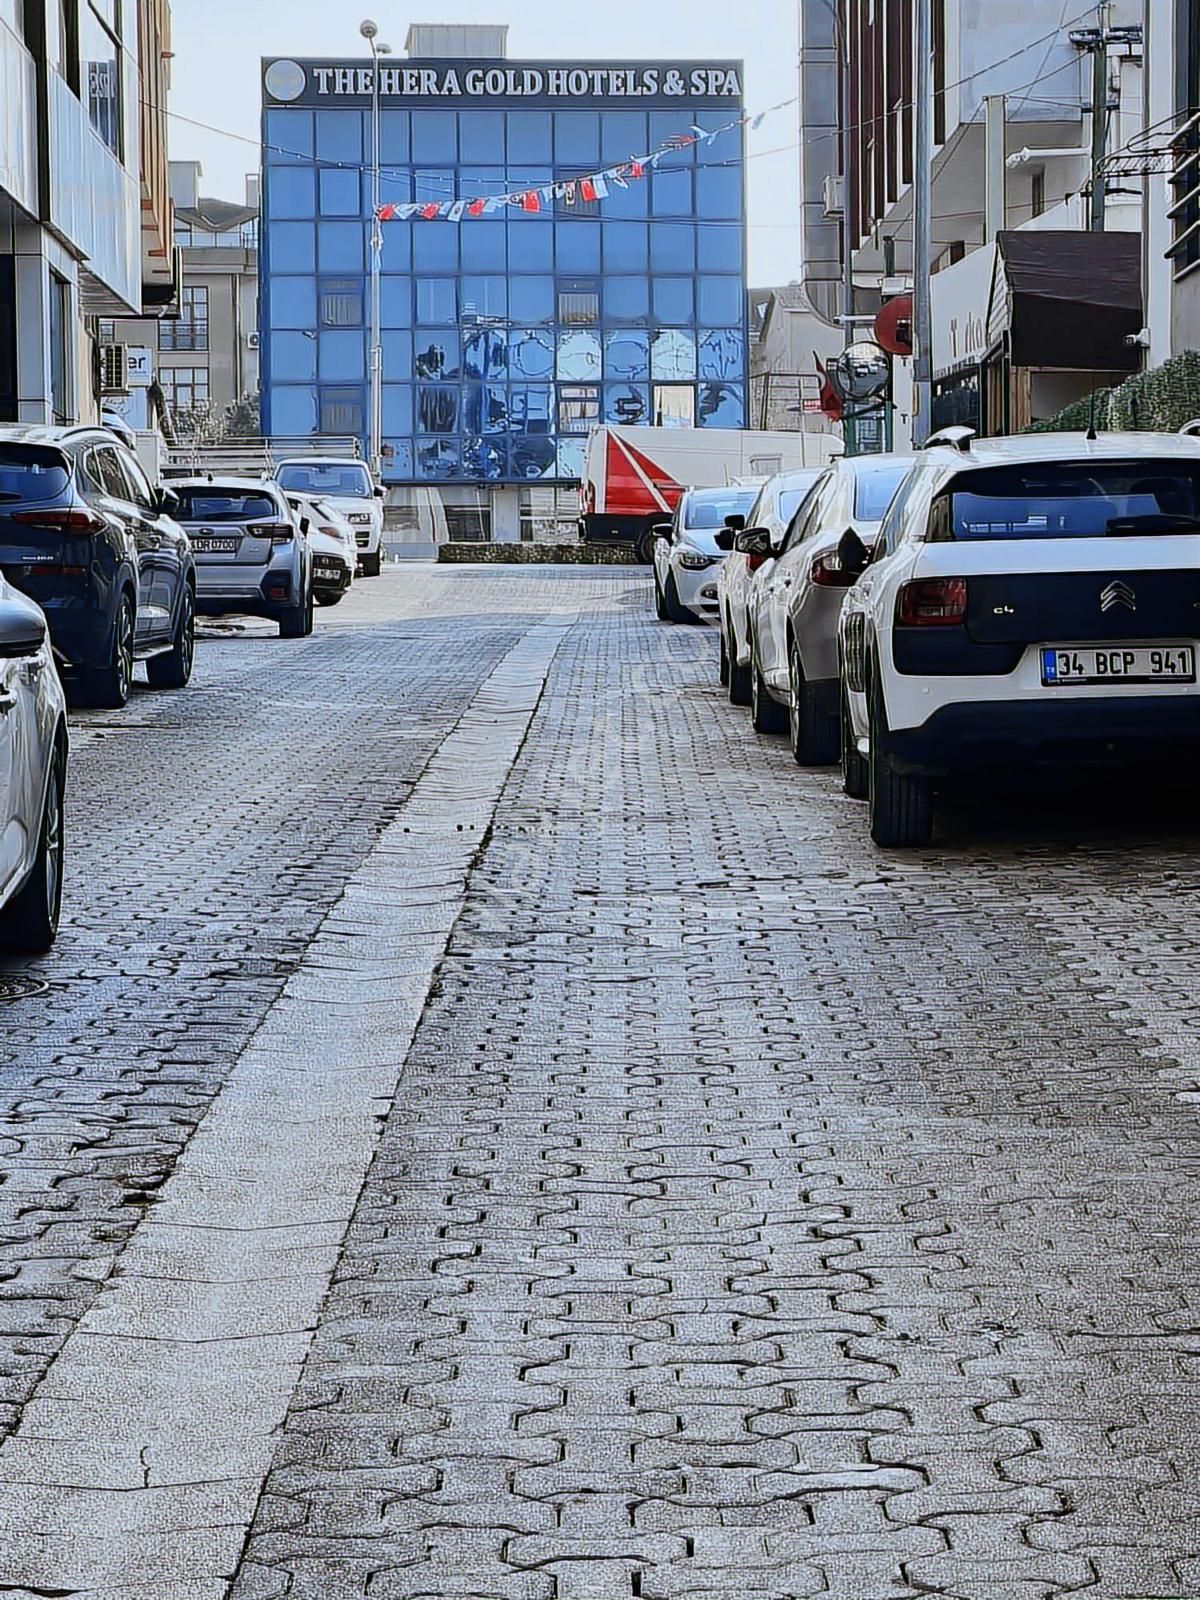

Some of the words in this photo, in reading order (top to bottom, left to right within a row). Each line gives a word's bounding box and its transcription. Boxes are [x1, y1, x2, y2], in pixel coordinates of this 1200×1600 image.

[313, 68, 373, 95] THE
[379, 68, 462, 96] HERA
[465, 69, 543, 96] GOLD
[547, 69, 659, 96] HOTELS
[663, 69, 686, 96] &
[690, 69, 742, 96] SPA
[1058, 652, 1084, 676] 34
[1095, 651, 1135, 675] BCP
[1150, 650, 1188, 674] 941
